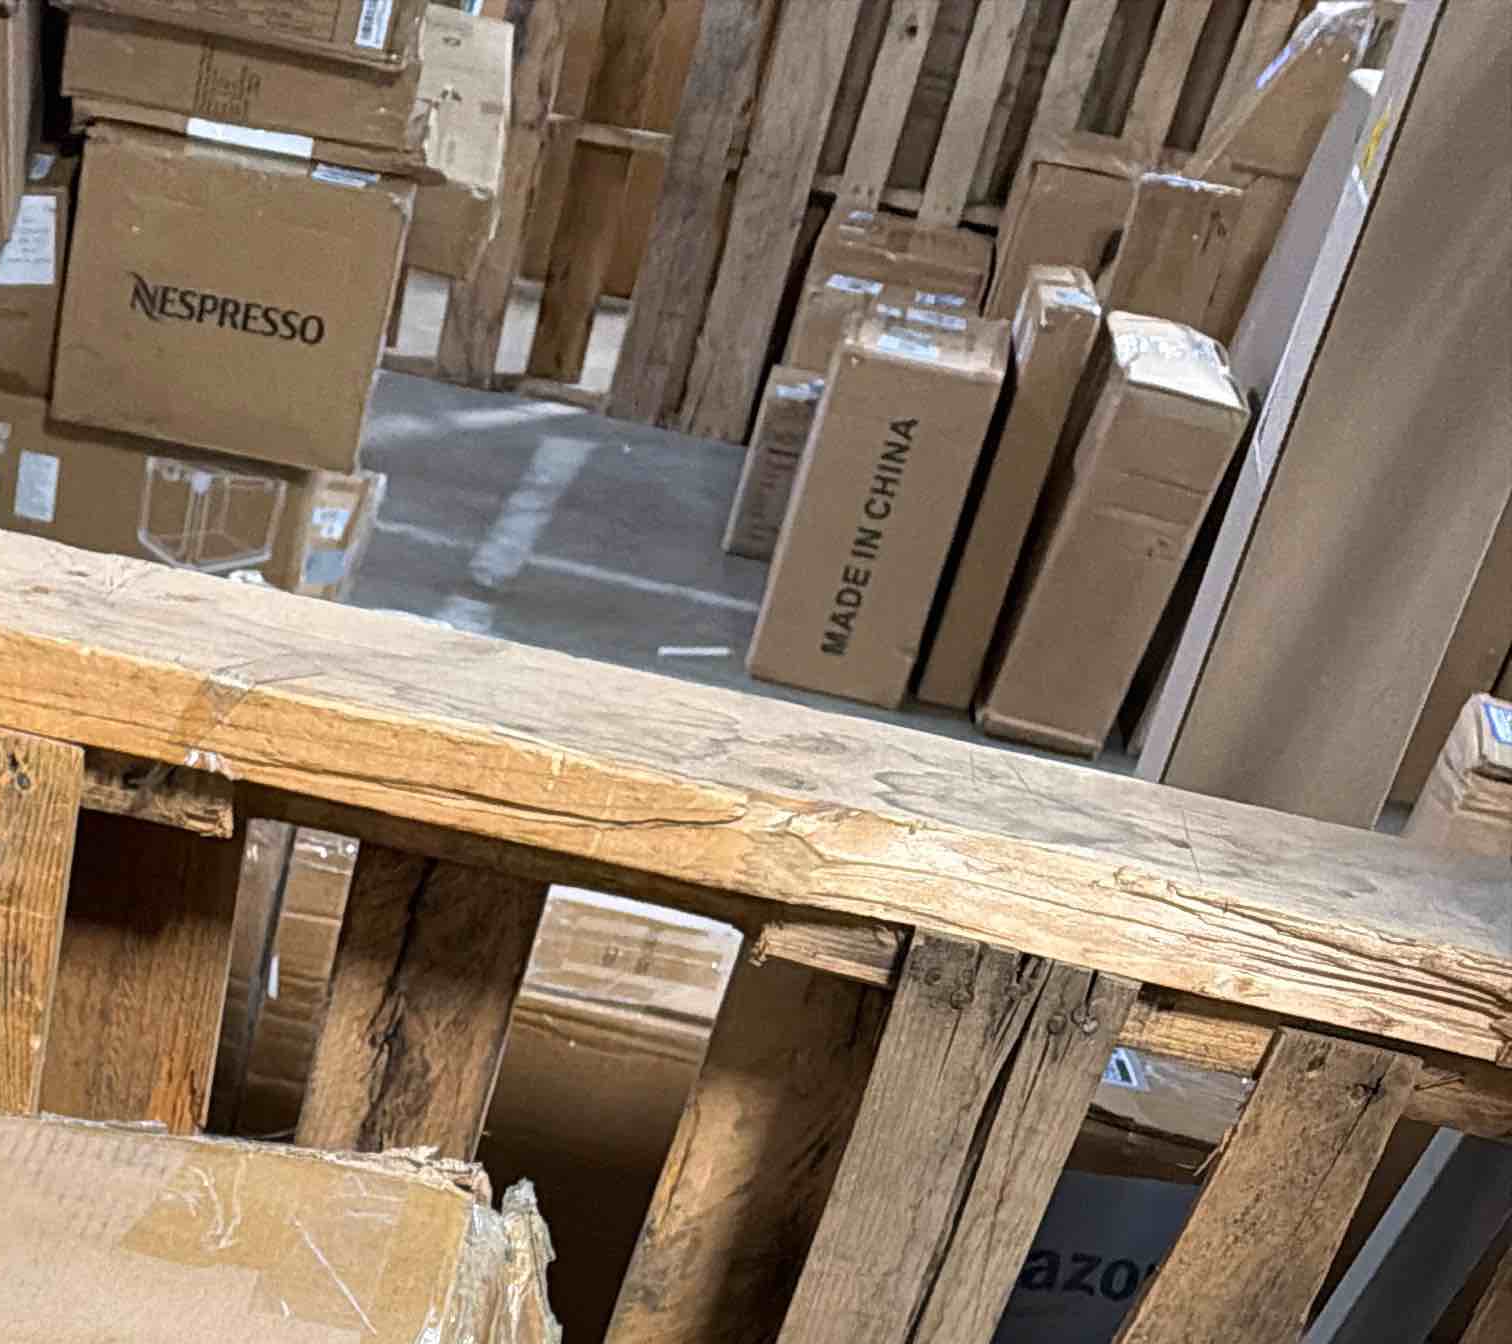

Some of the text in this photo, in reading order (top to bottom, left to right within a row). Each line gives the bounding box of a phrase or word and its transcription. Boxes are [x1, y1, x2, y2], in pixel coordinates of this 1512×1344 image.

[126, 271, 326, 345] NESPRESSO
[820, 417, 920, 656] MADE IN CHINA
[1021, 1249, 1160, 1302] azo
